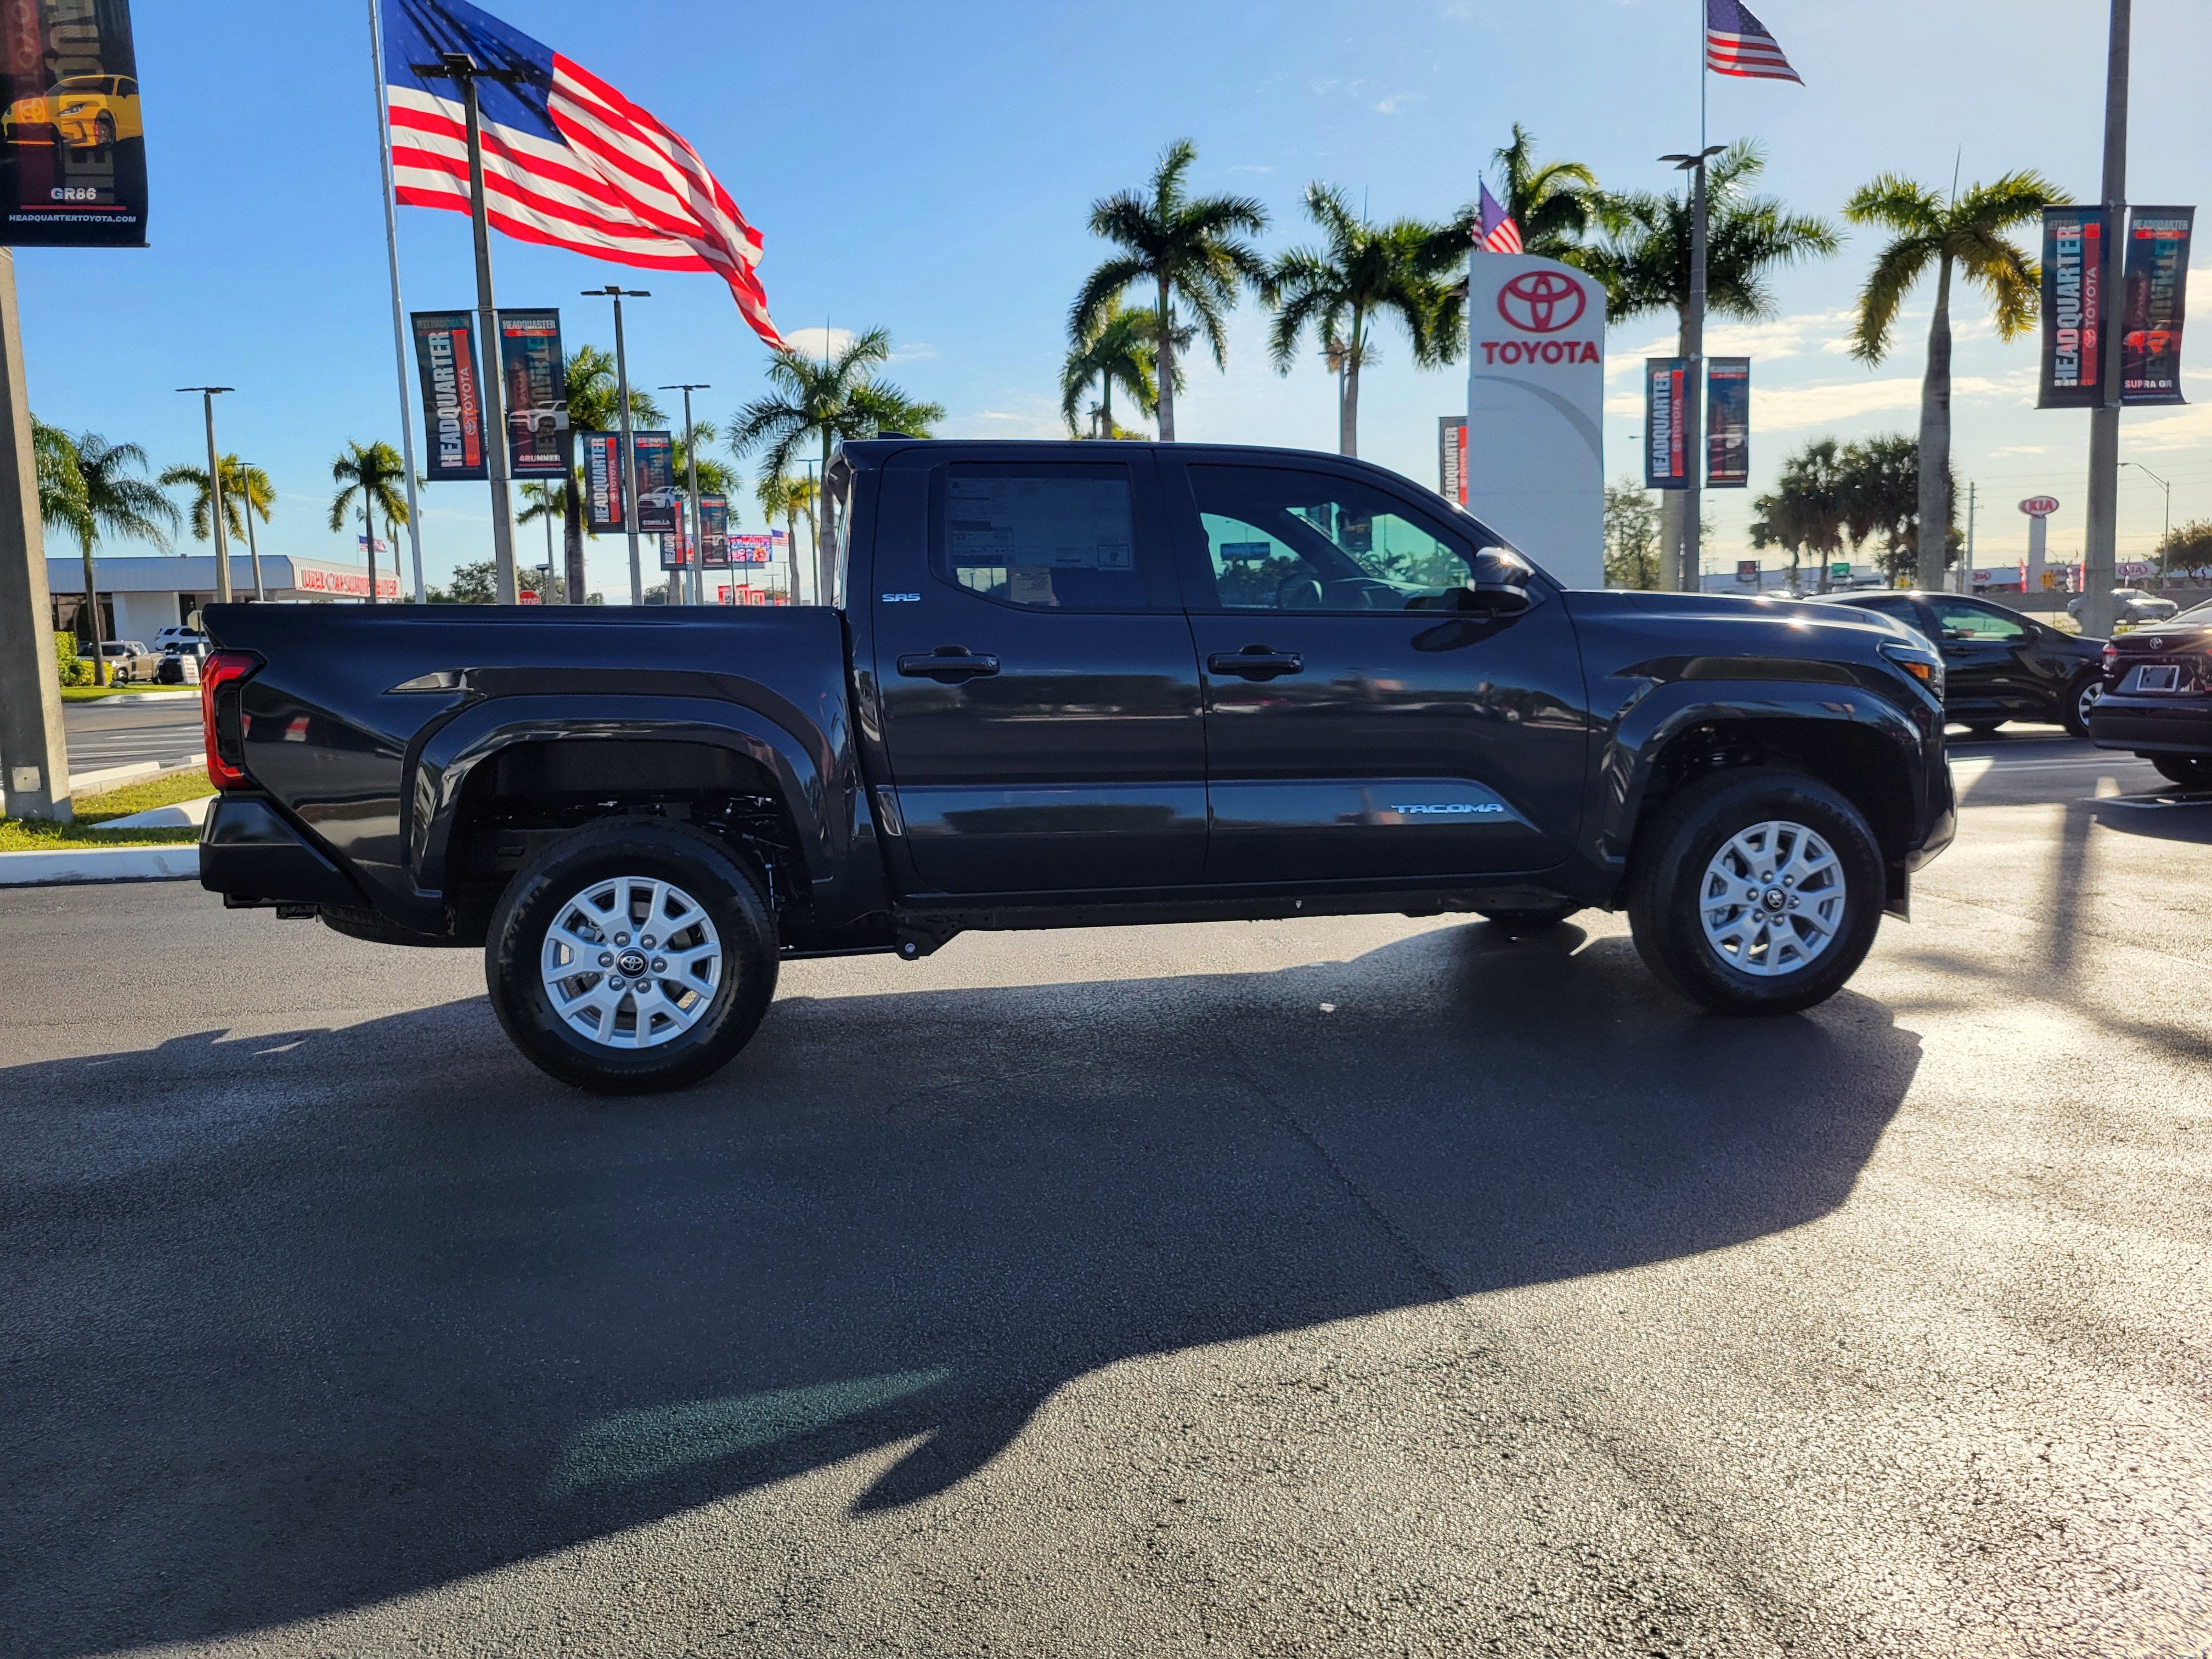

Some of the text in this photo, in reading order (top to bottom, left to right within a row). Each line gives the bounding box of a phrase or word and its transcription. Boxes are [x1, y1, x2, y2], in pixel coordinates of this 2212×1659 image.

[51, 187, 97, 200] GR86
[2054, 225, 2083, 386] HEADQUARTER
[2085, 267, 2097, 328] TOYOTA
[502, 319, 556, 330] HEADQUARTER
[1481, 341, 1600, 364] TOYOTA
[461, 366, 478, 417] TOYOTA
[2124, 380, 2156, 388] SUPRA
[428, 331, 463, 467] HEADQUARTER
[591, 437, 610, 523] HEADQUARTER
[2029, 499, 2053, 510] KIA
[882, 593, 921, 602] SR5
[1390, 803, 1505, 814] TACOMA
